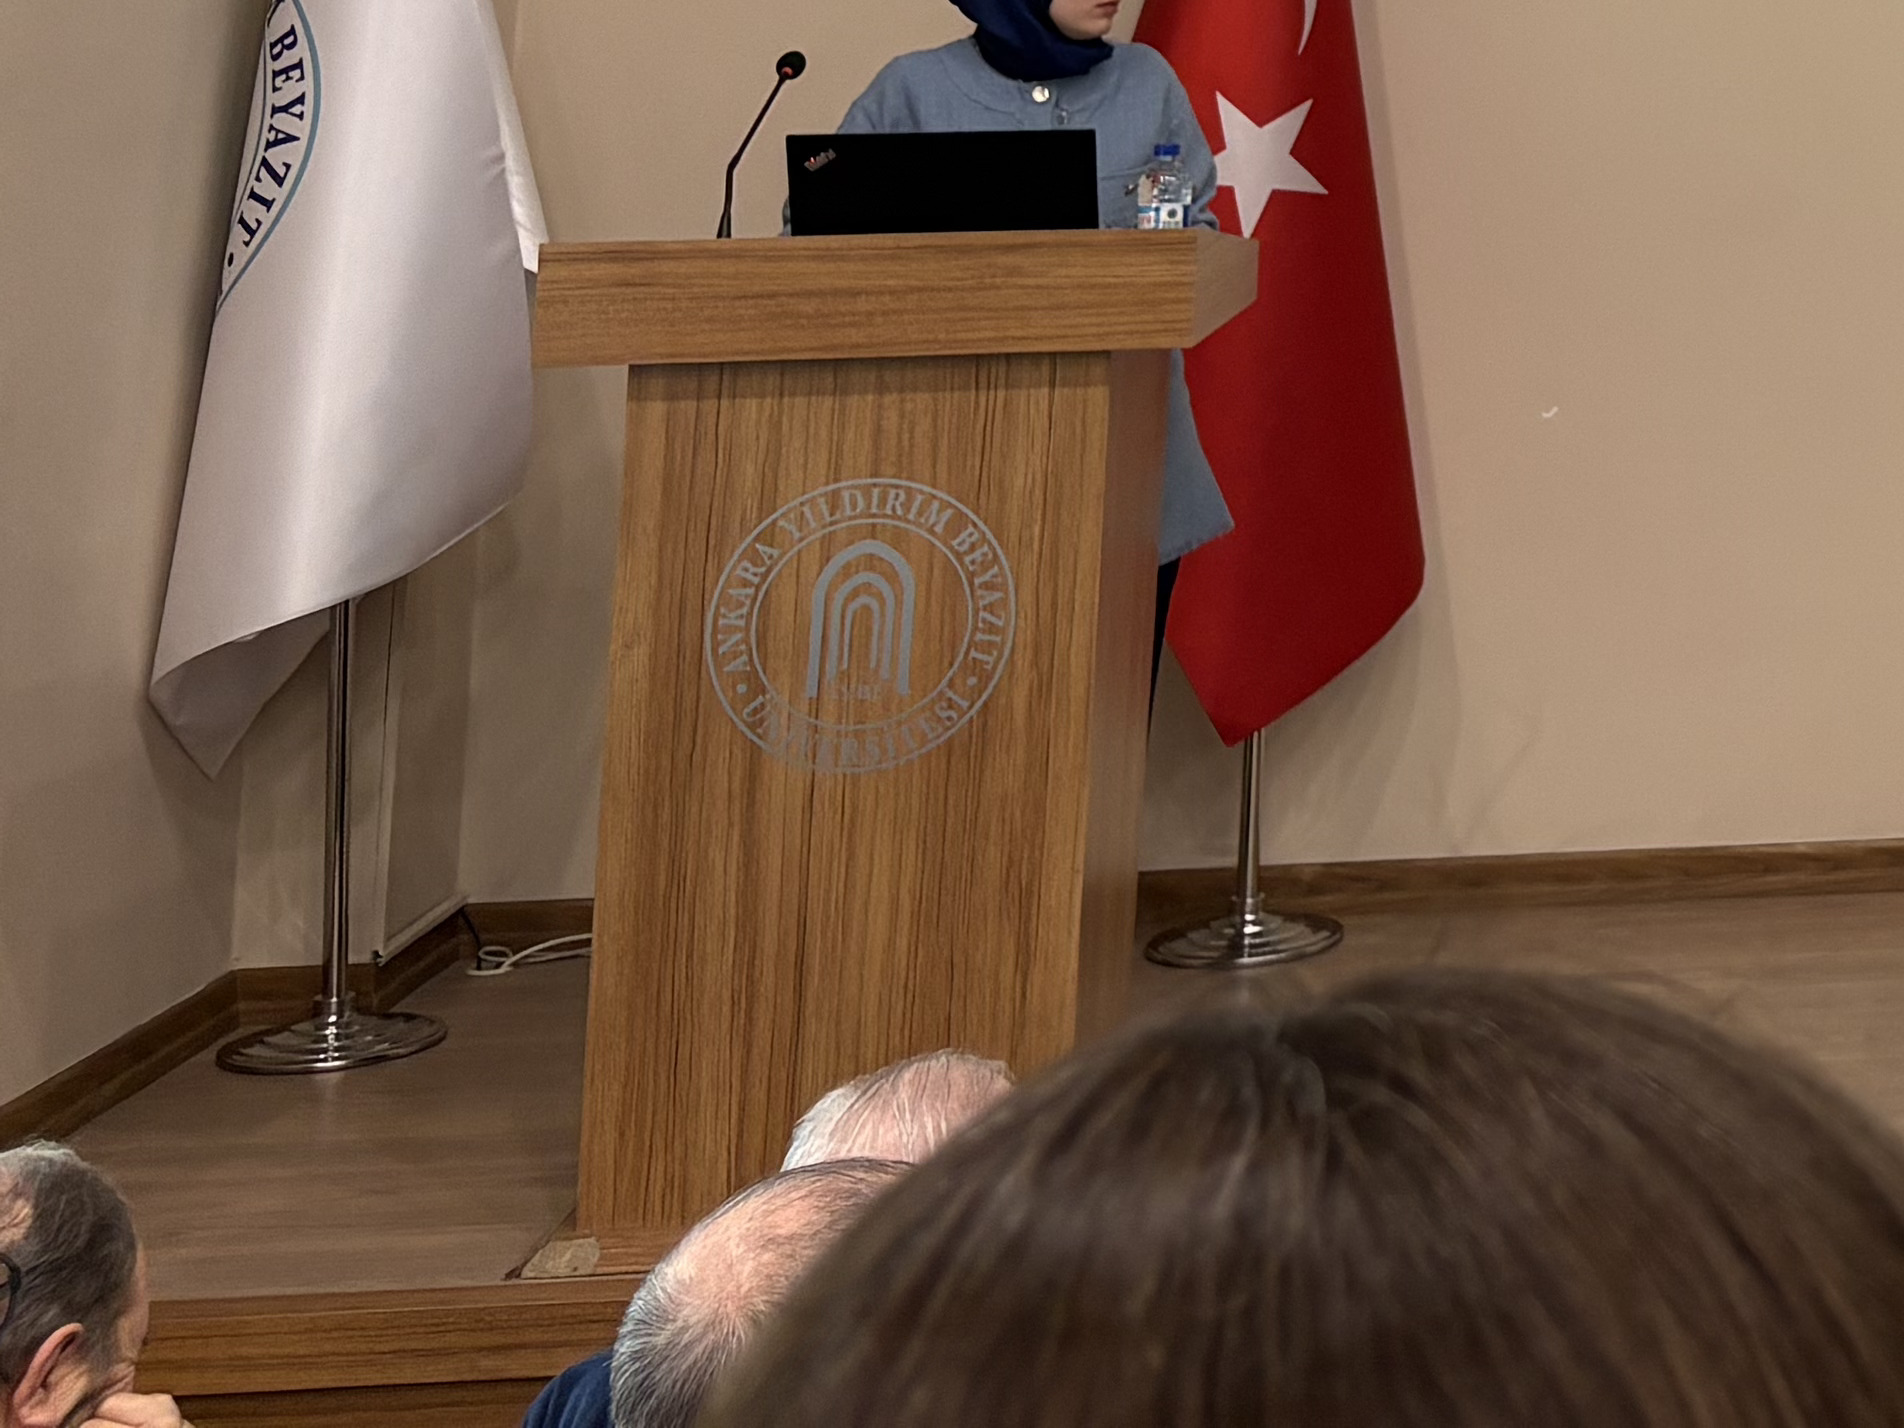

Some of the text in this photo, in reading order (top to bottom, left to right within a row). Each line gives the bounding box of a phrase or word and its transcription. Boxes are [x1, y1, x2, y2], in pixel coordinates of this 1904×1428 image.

[236, 24, 306, 248] BEYAZIT
[718, 488, 1007, 673] ANKARA YILDIRIM BEYAZIT
